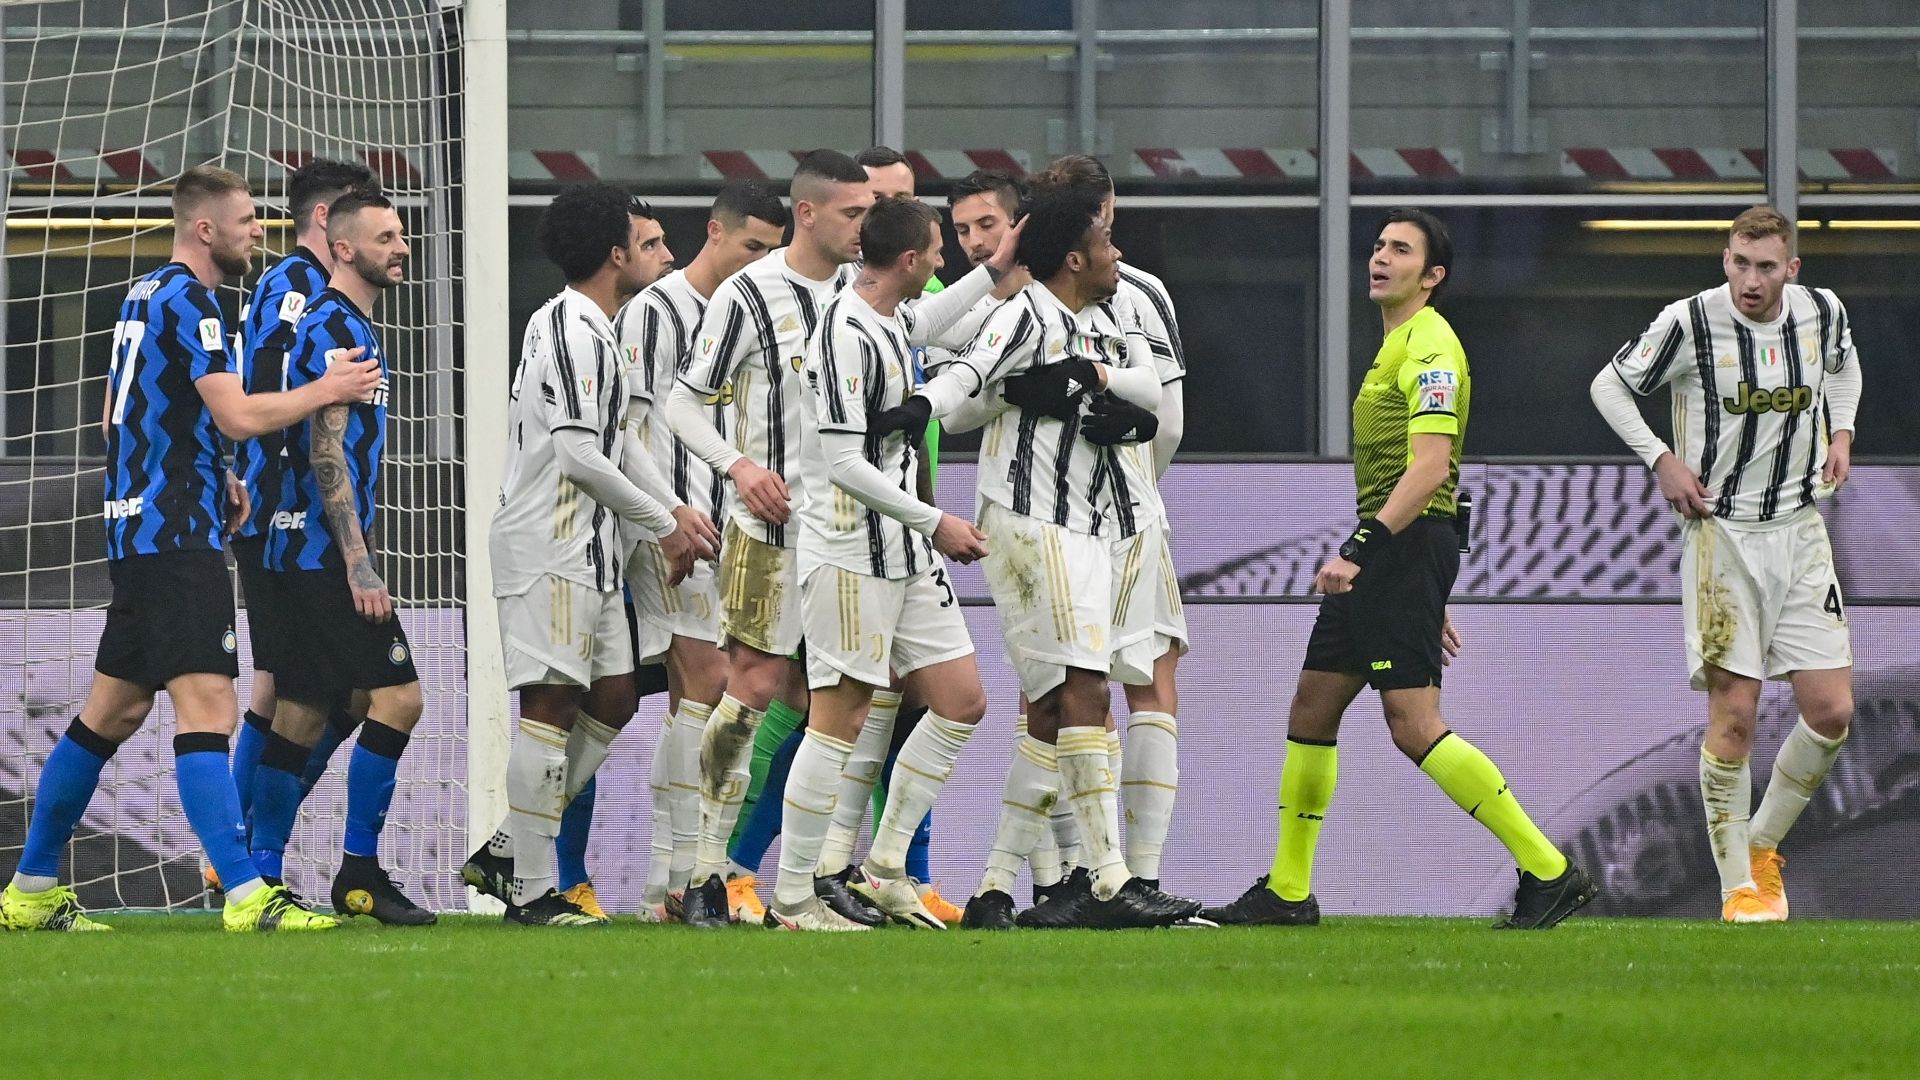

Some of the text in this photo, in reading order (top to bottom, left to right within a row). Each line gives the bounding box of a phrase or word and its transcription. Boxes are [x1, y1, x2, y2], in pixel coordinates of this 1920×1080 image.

[1418, 371, 1454, 387] NET
[1722, 381, 1813, 417] Jeep
[1823, 583, 1843, 622] 4
